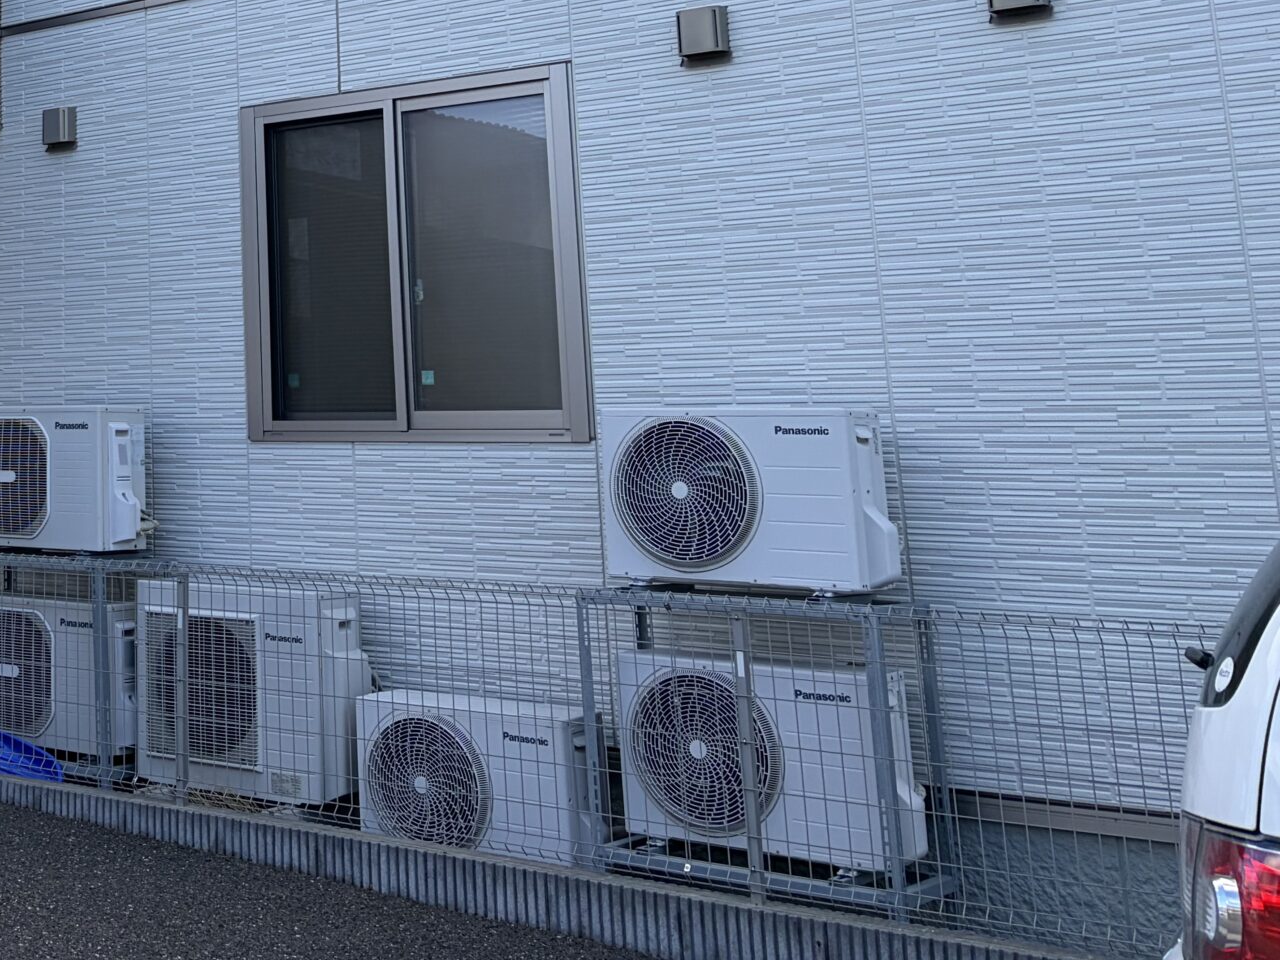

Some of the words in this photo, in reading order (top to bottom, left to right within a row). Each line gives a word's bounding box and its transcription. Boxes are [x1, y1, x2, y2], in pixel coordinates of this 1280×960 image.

[54, 421, 89, 430] Panasonic
[774, 425, 830, 436] Panasonic
[793, 689, 852, 703] Panasonic
[503, 731, 549, 746] Panasonic
